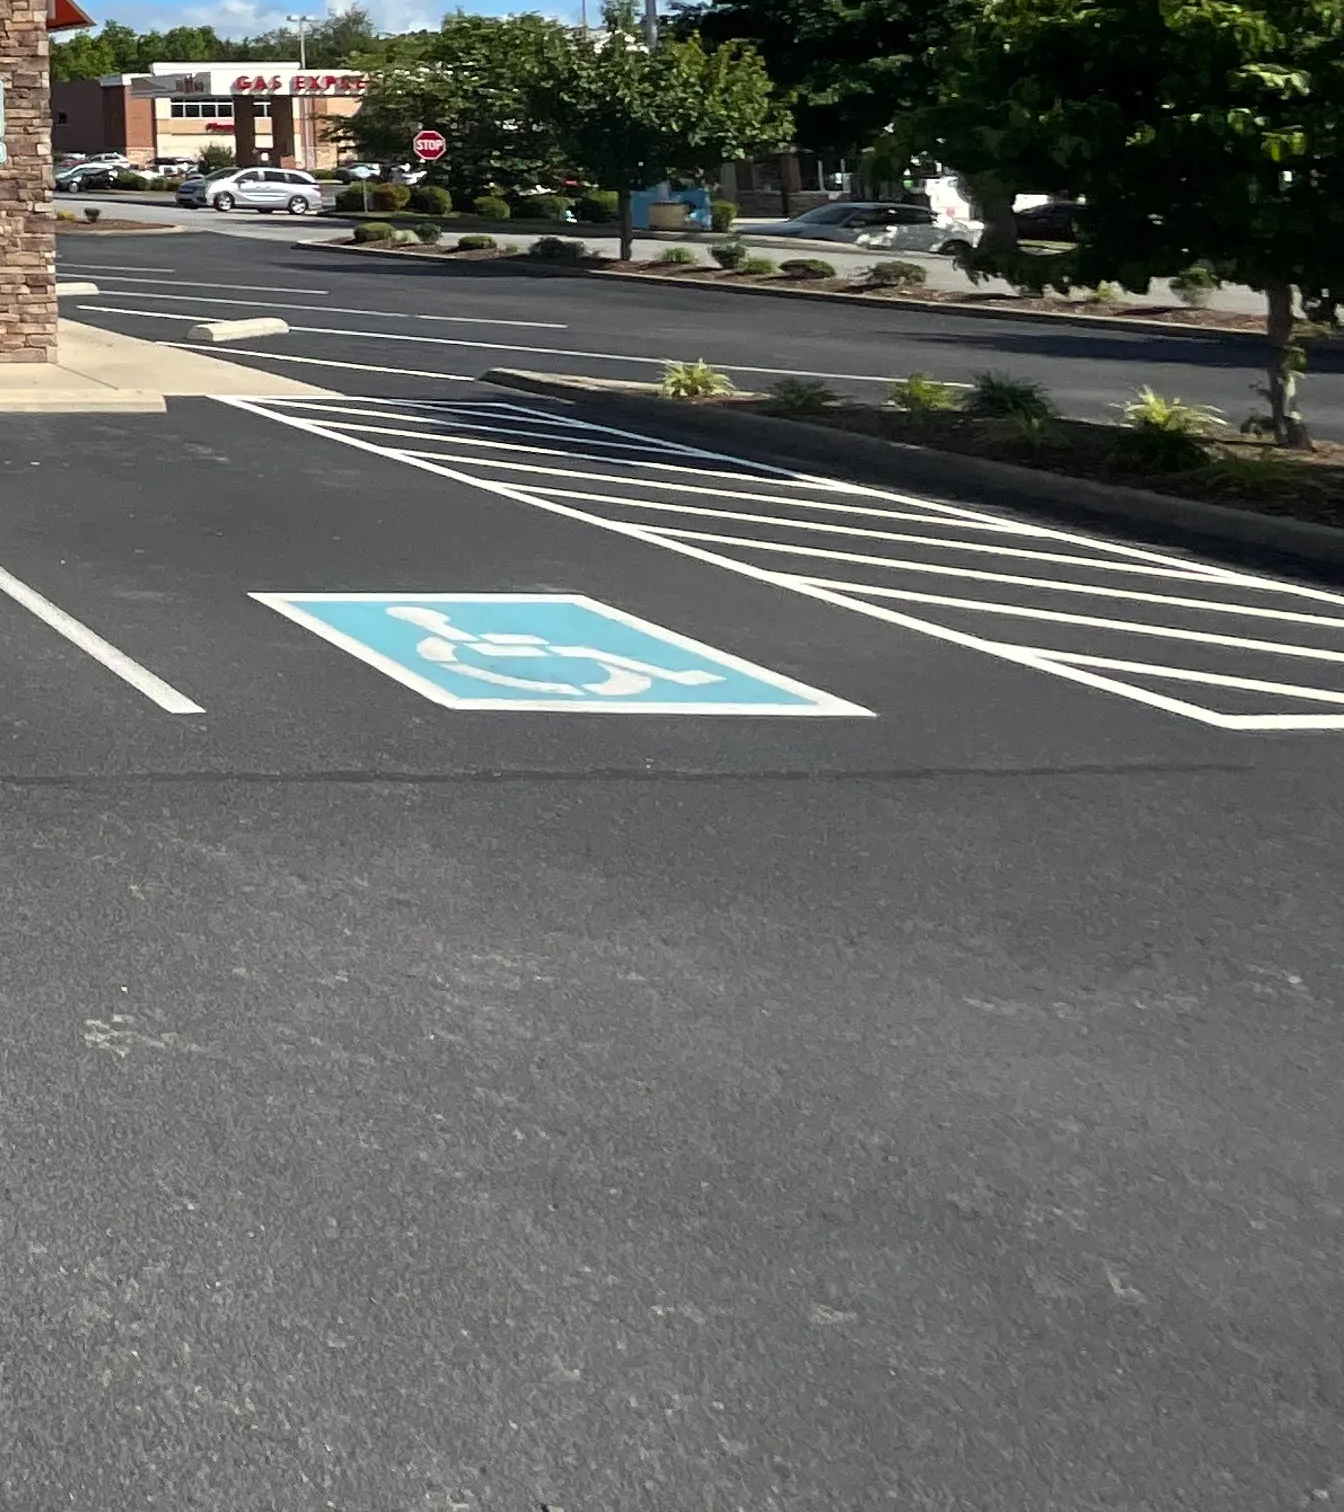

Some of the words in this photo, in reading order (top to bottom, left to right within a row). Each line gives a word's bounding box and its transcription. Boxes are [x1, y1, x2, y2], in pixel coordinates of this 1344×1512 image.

[236, 75, 282, 90] GAS
[294, 75, 368, 90] EXPRE
[416, 139, 443, 150] STOP
